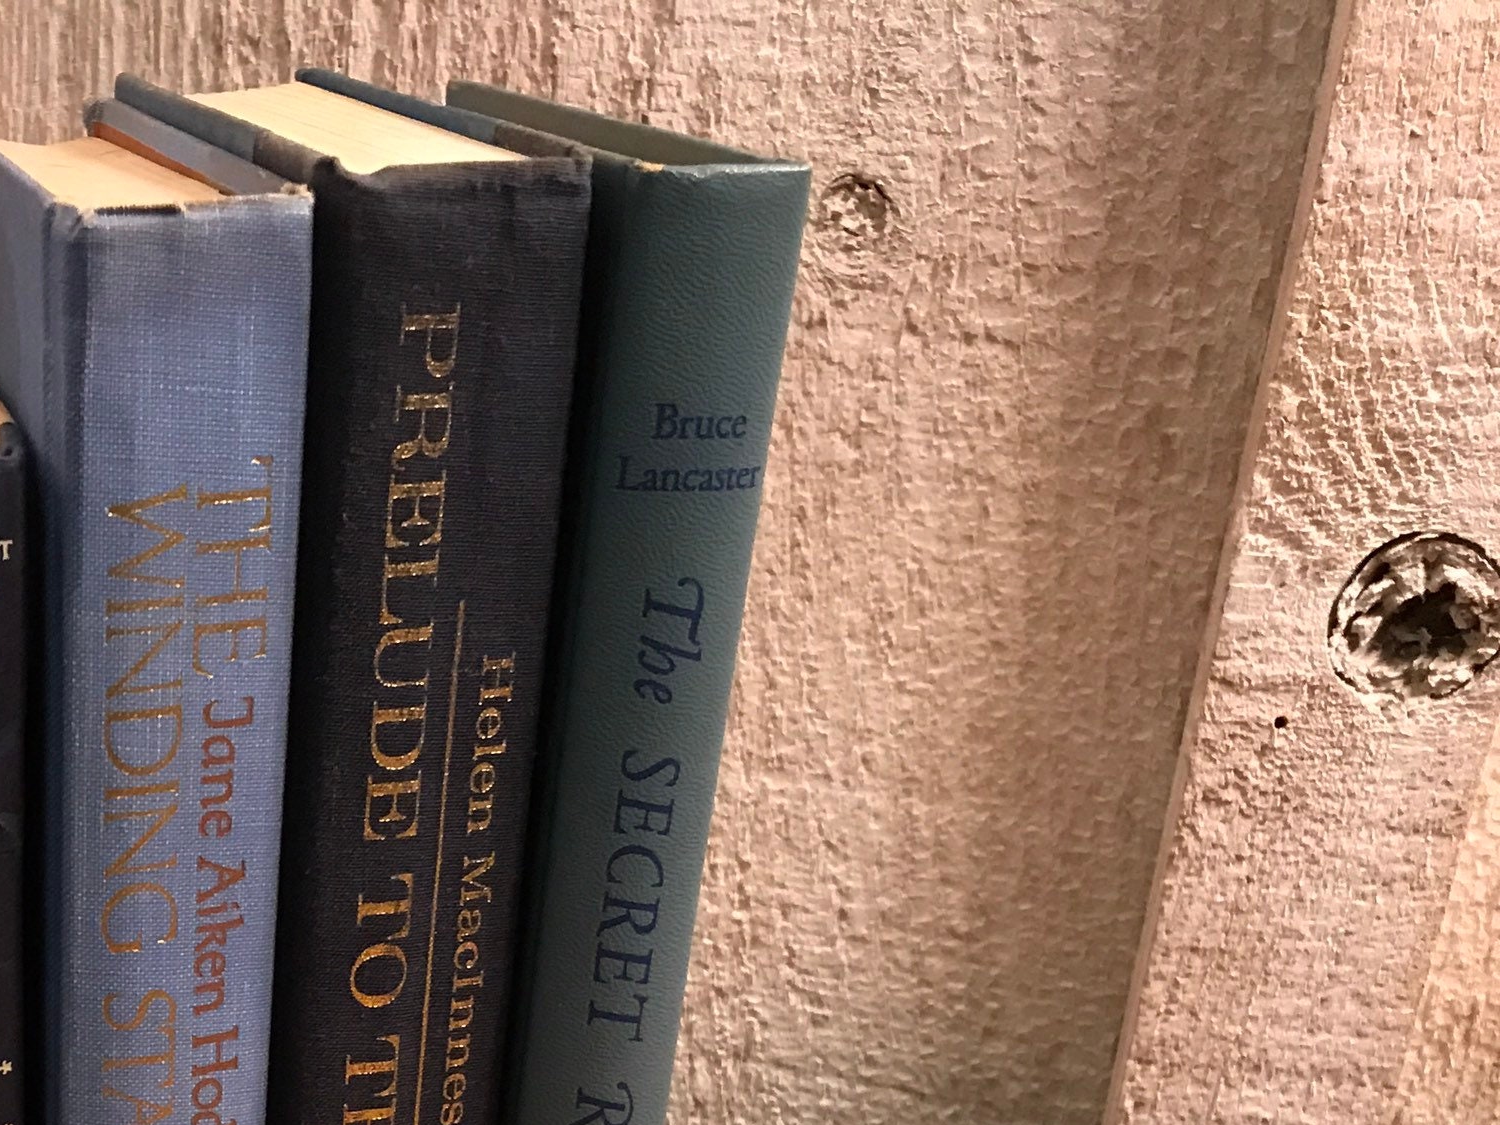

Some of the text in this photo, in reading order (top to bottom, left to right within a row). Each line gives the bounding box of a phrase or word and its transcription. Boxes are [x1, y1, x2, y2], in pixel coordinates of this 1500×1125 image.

[615, 460, 760, 492] Lancaster
[652, 403, 746, 441] Bruce
[192, 455, 274, 680] THE
[365, 302, 460, 842] PRELUDE
[634, 577, 704, 704] The
[103, 481, 188, 954] WINDING
[199, 696, 254, 838] Jane
[467, 652, 516, 834] Helen
[192, 856, 246, 1016] Aiken
[349, 872, 413, 1009] TO
[587, 747, 681, 1042] SECRET
